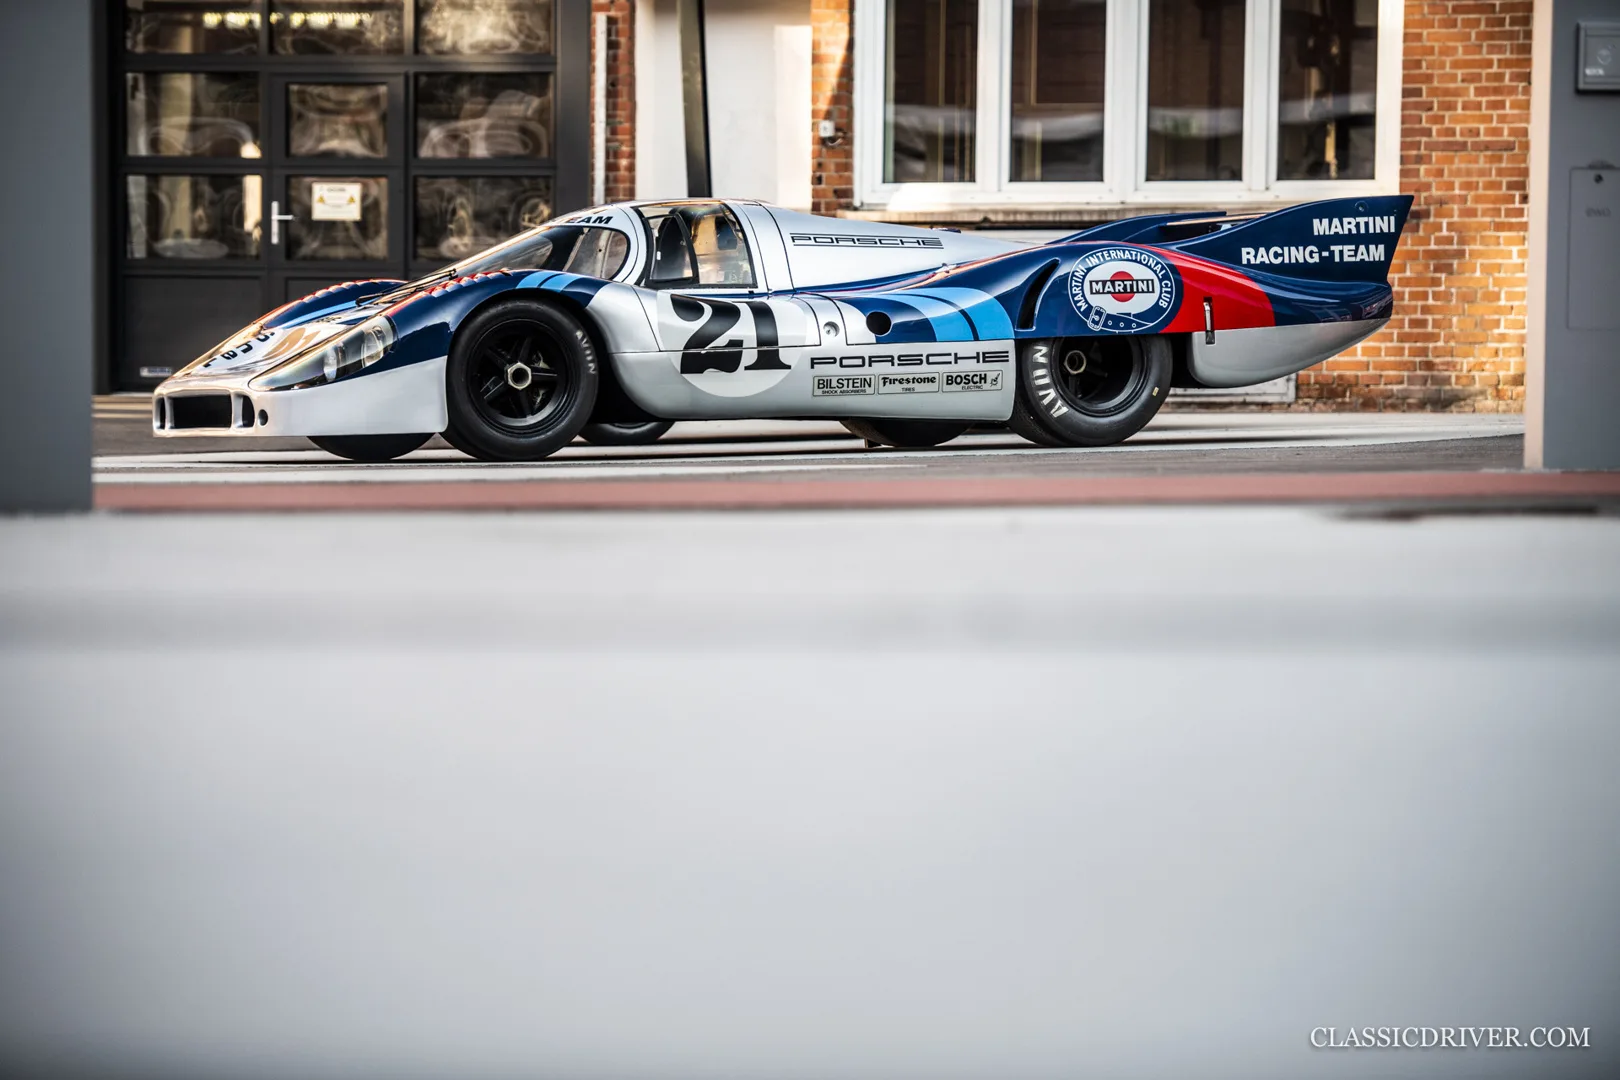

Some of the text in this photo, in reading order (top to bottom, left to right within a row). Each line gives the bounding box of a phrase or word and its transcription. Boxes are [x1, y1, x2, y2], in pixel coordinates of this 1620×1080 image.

[1313, 216, 1395, 236] MARTINI
[791, 235, 943, 247] PORSCHE
[1241, 244, 1385, 265] RACING-TEAM
[1071, 249, 1172, 312] MARTINI INTERNATIONAL CLUB
[1091, 280, 1153, 293] MARTINI
[670, 293, 792, 374] 21
[810, 351, 1010, 370] PORSCHE
[817, 377, 872, 390] BILSTEIN
[881, 375, 937, 387] Firestone
[945, 373, 988, 386] BOSCH
